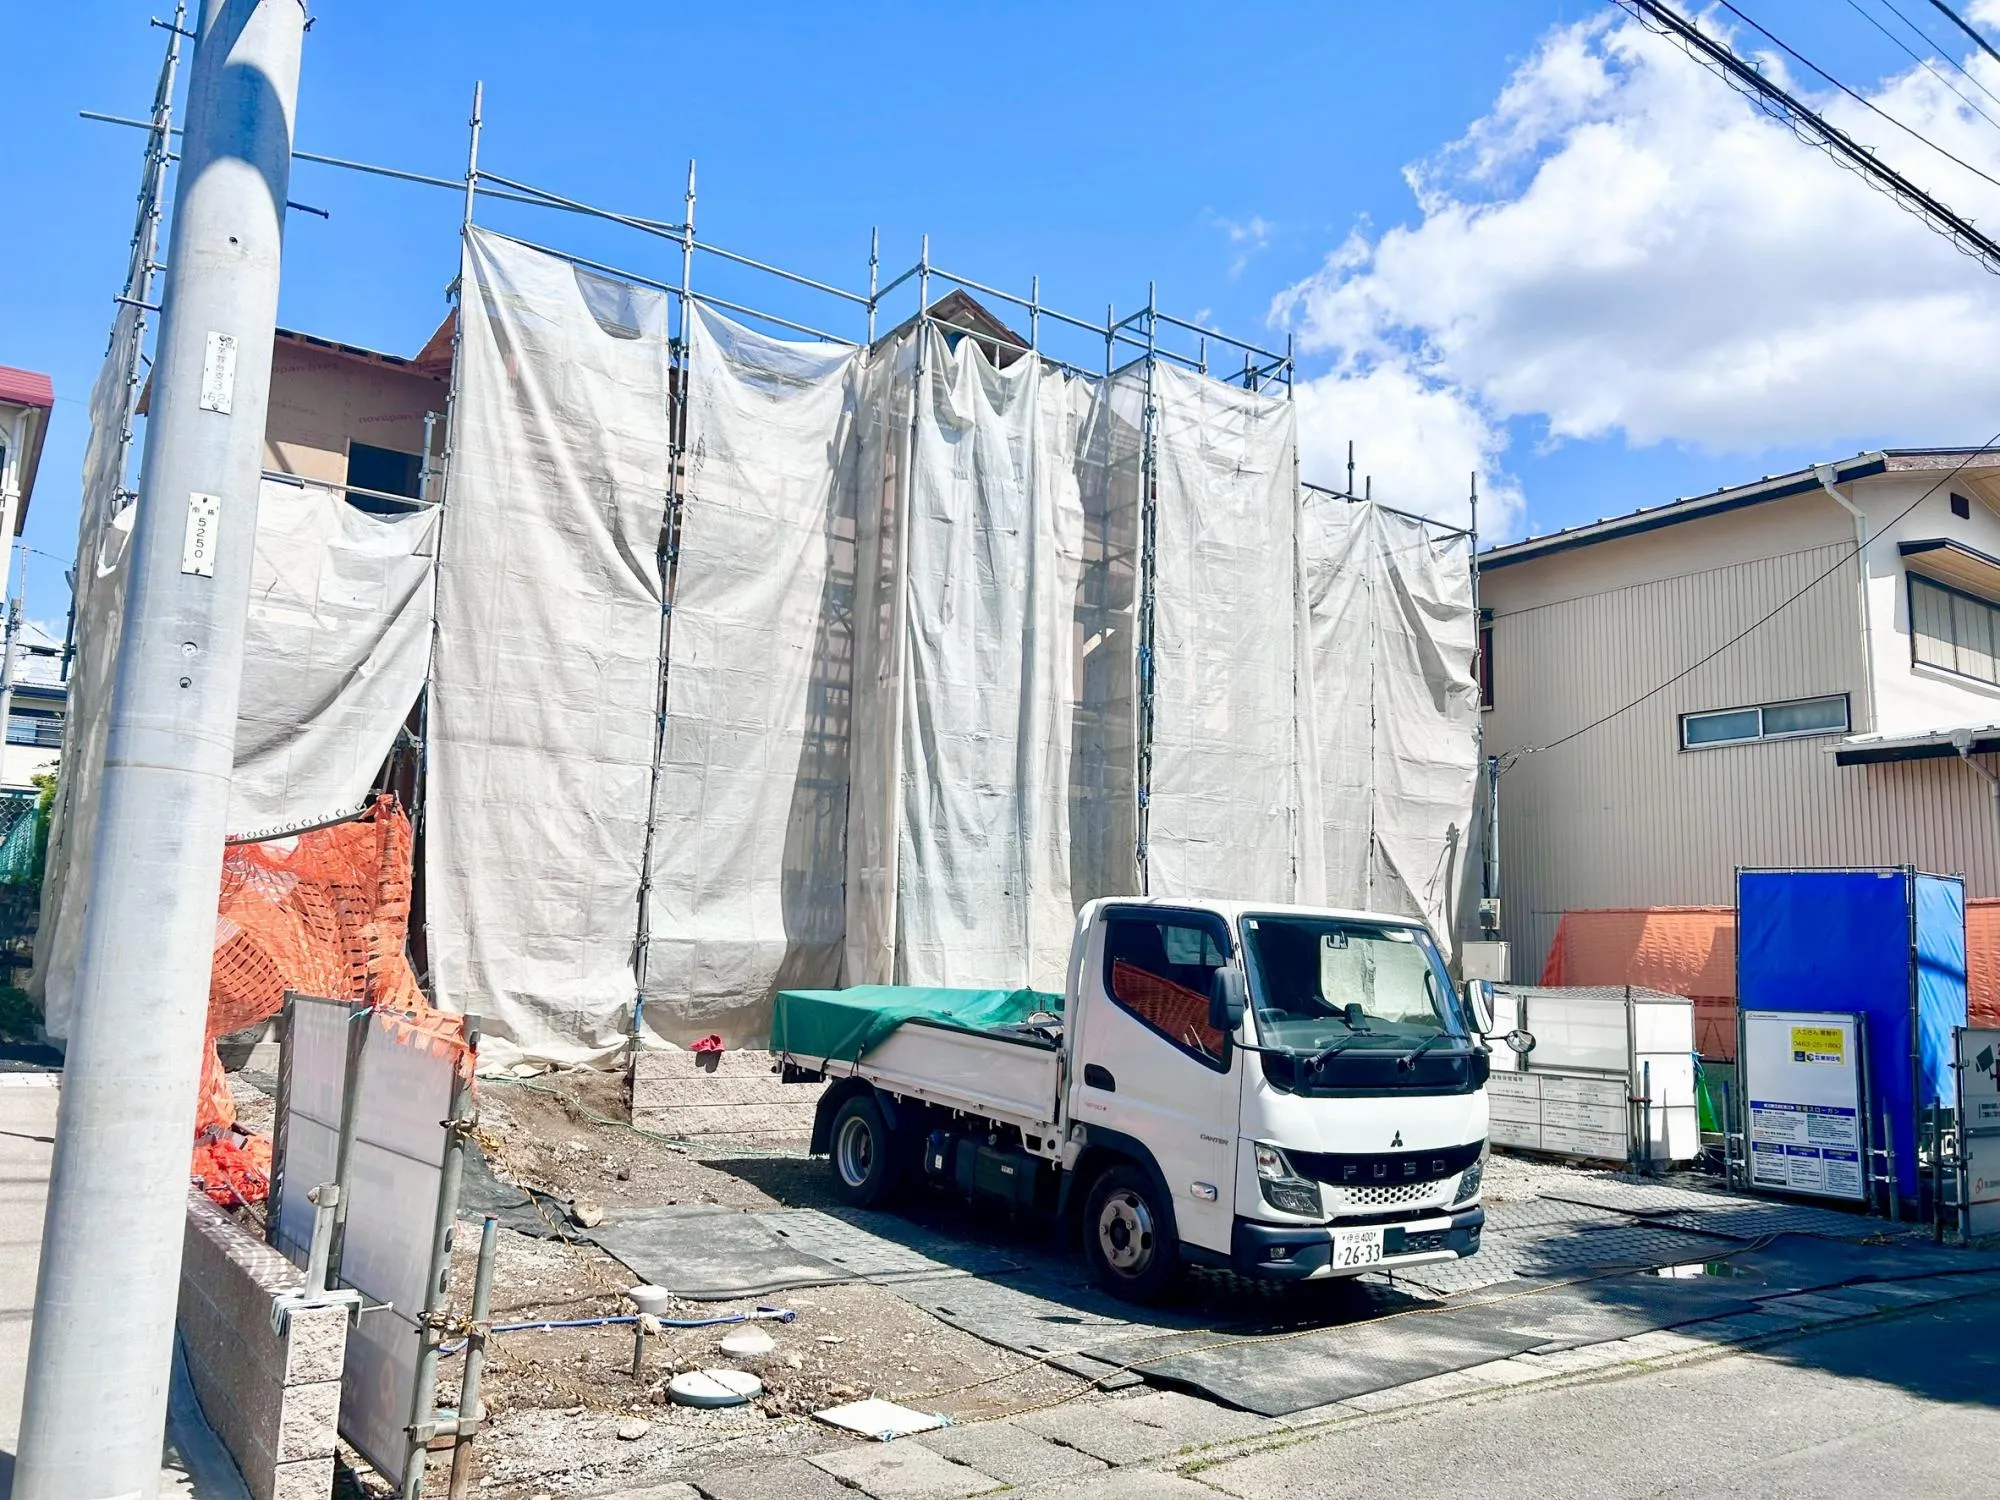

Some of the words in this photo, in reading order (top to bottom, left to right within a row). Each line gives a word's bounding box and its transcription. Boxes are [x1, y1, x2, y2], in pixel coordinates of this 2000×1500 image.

[194, 517, 207, 559] 5250
[1200, 1133, 1229, 1146] CANTER
[1343, 1158, 1446, 1180] FUSO
[1344, 1243, 1381, 1266] 26-33
